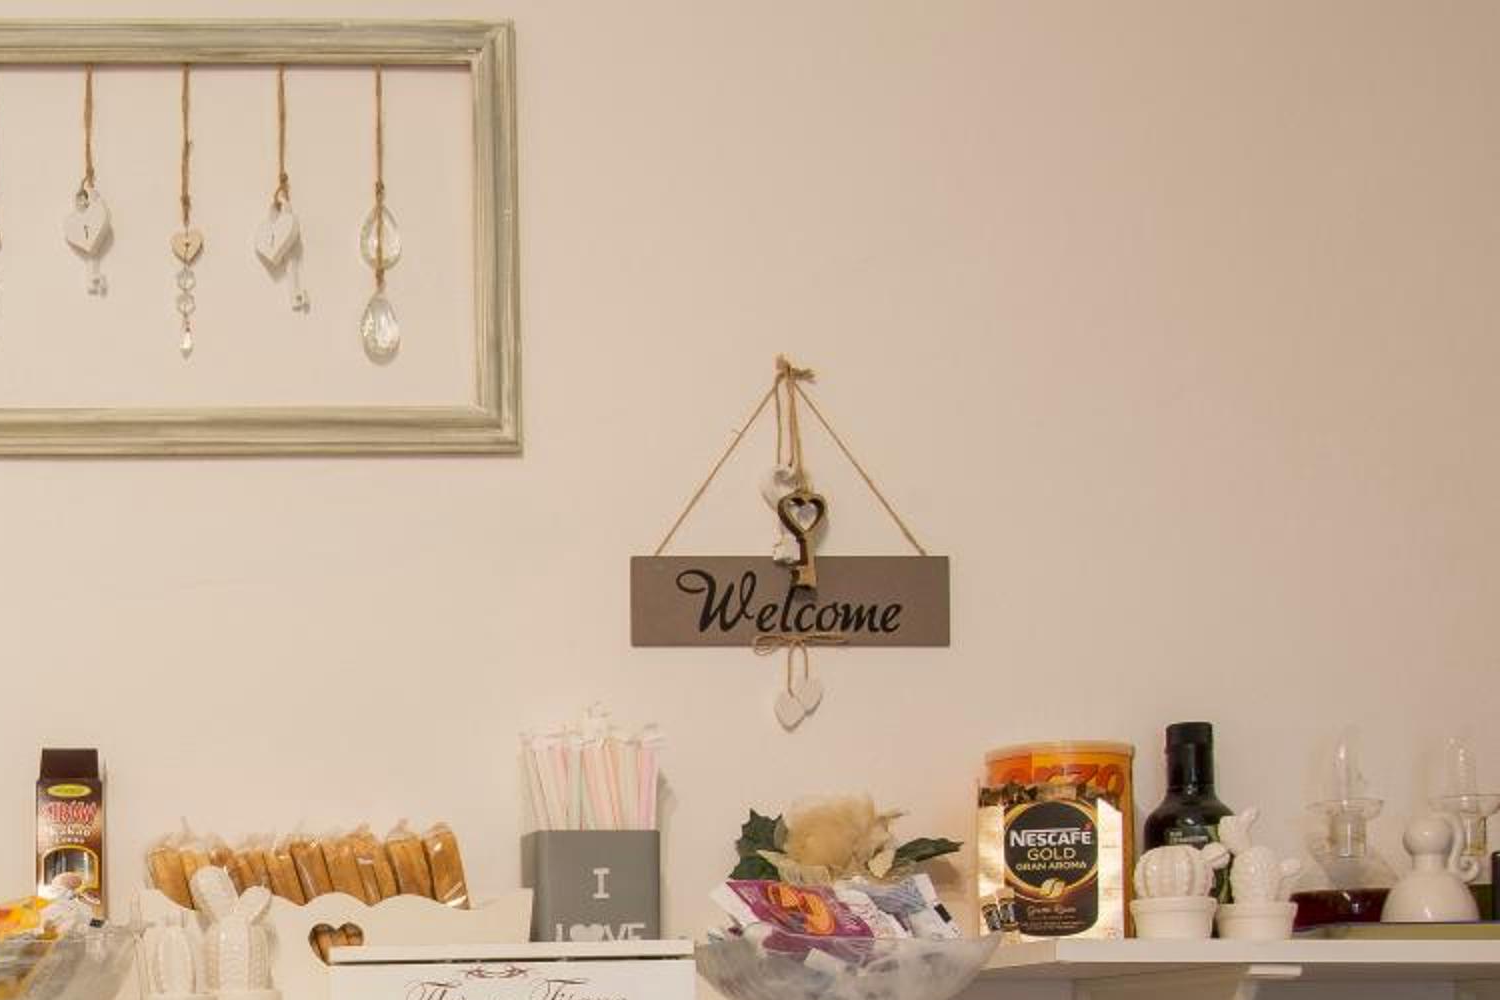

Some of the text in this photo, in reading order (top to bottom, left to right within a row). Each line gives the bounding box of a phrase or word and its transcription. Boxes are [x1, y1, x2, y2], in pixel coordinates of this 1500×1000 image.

[675, 568, 904, 633] Welcome
[1027, 847, 1077, 861] GOLD
[1015, 860, 1088, 872] GRAN AROMA
